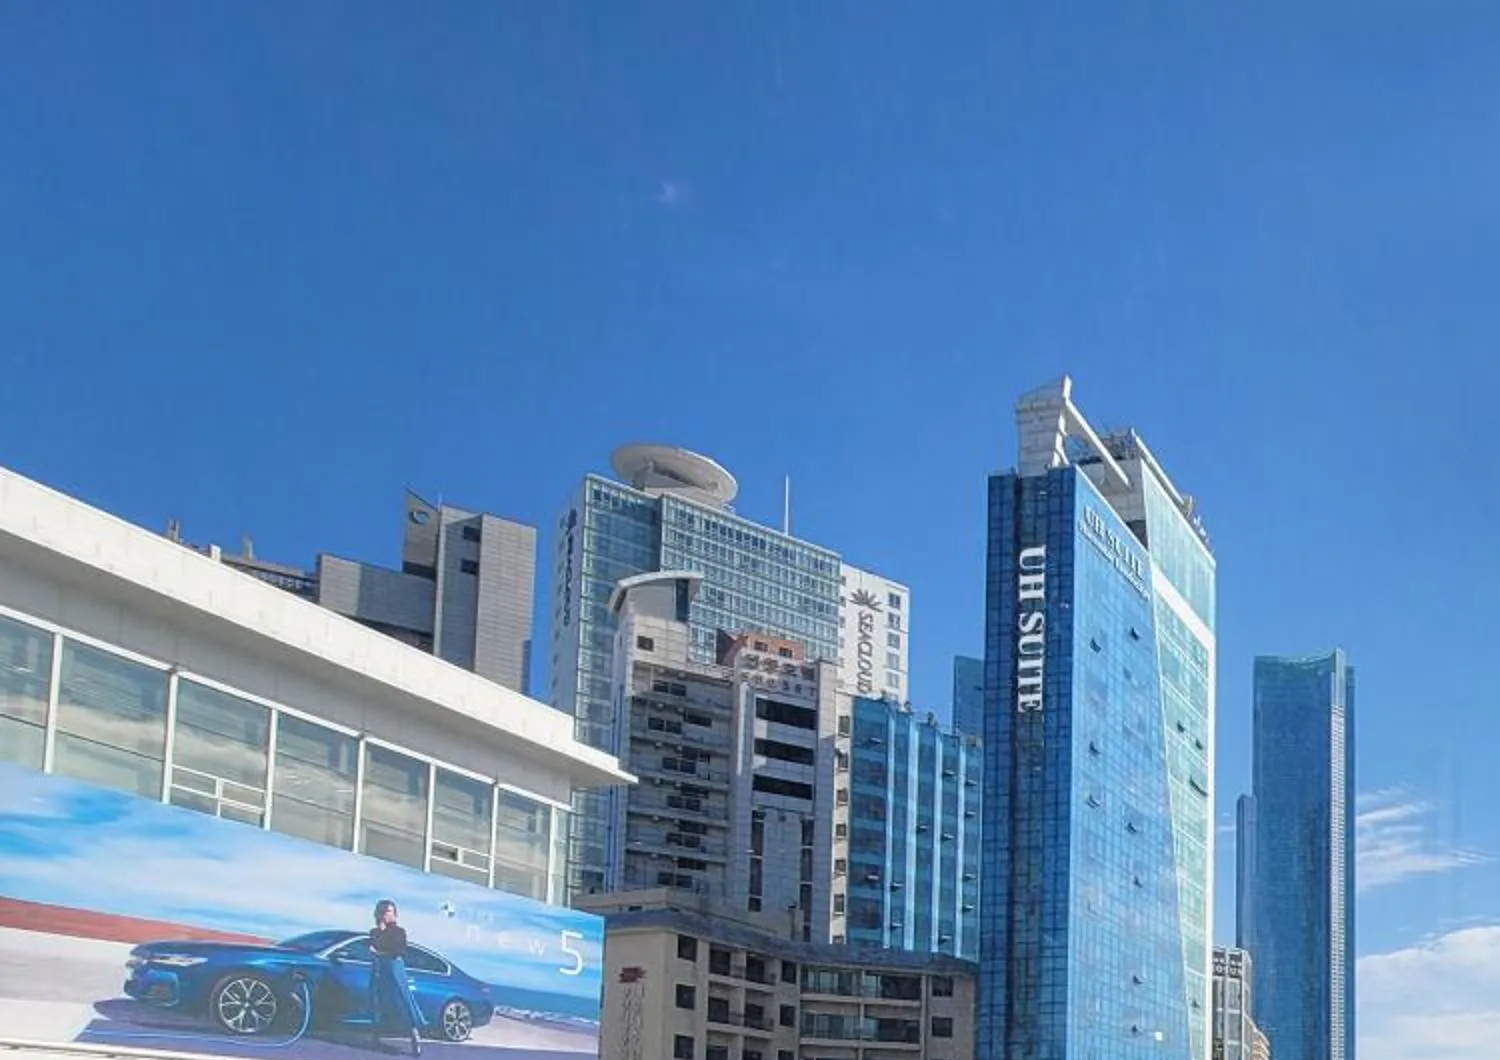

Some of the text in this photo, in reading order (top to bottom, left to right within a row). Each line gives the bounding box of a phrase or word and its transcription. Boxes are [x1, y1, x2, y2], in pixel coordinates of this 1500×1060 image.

[857, 610, 874, 693] SEACLOUD
[1017, 544, 1046, 713] UH SUITE
[559, 929, 585, 976] 5
